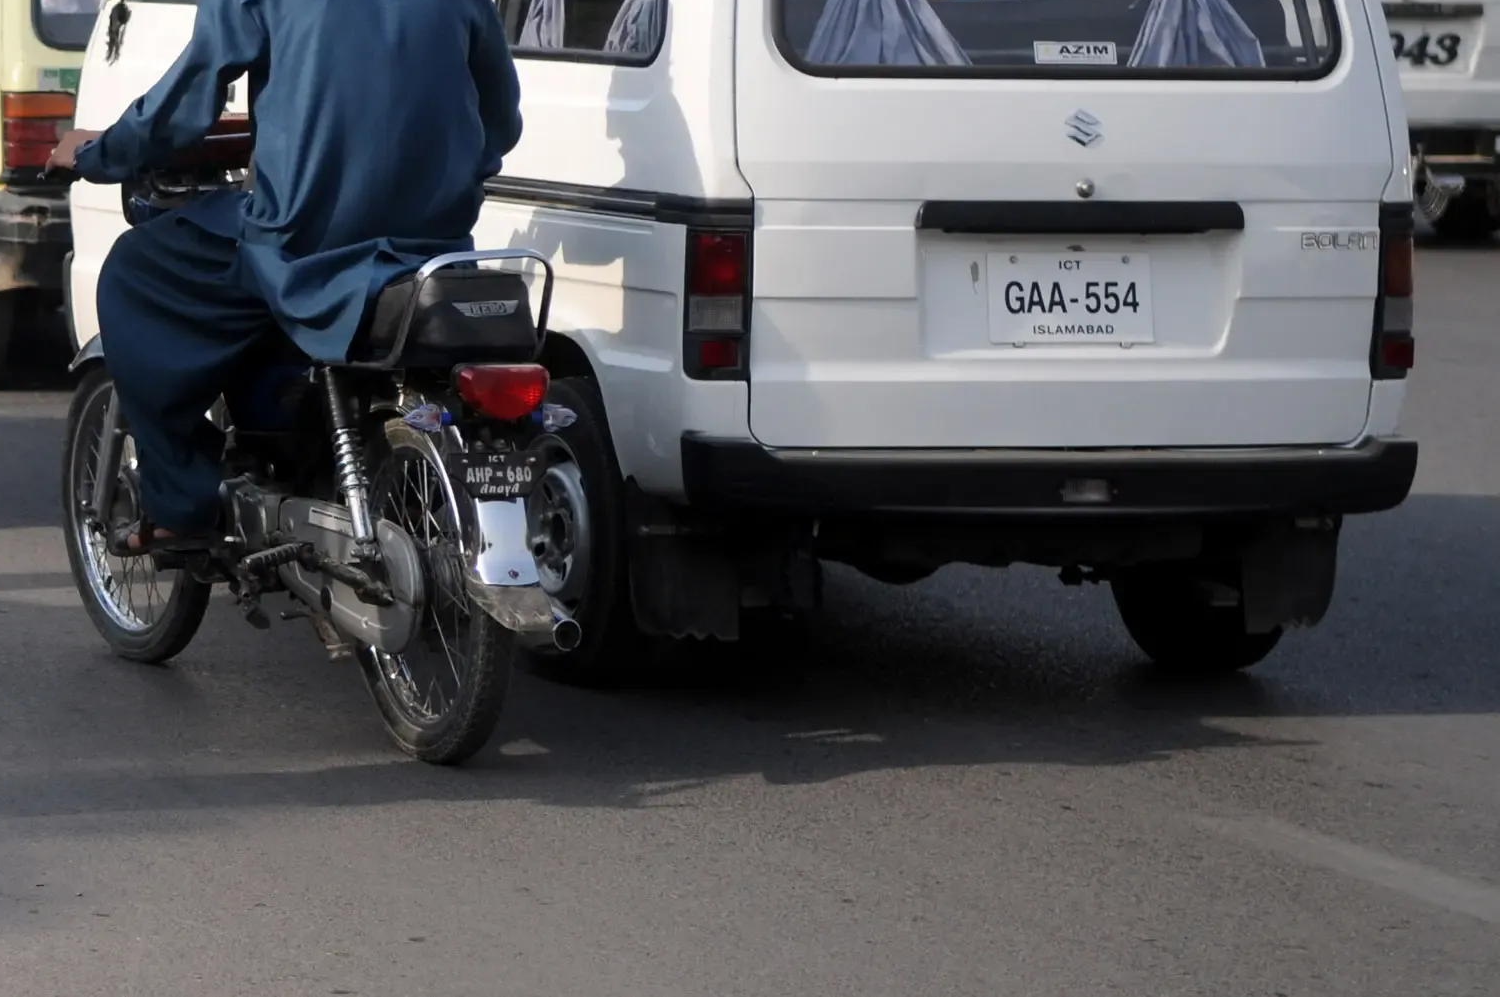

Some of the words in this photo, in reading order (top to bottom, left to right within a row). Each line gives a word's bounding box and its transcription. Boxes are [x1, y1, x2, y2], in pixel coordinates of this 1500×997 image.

[1058, 45, 1109, 55] AZIM
[1300, 232, 1378, 250] BOLAN
[1058, 260, 1083, 271] ICT
[1004, 280, 1140, 314] GAA-554
[1032, 324, 1114, 335] ISLAMABAD
[487, 454, 506, 463] ICT
